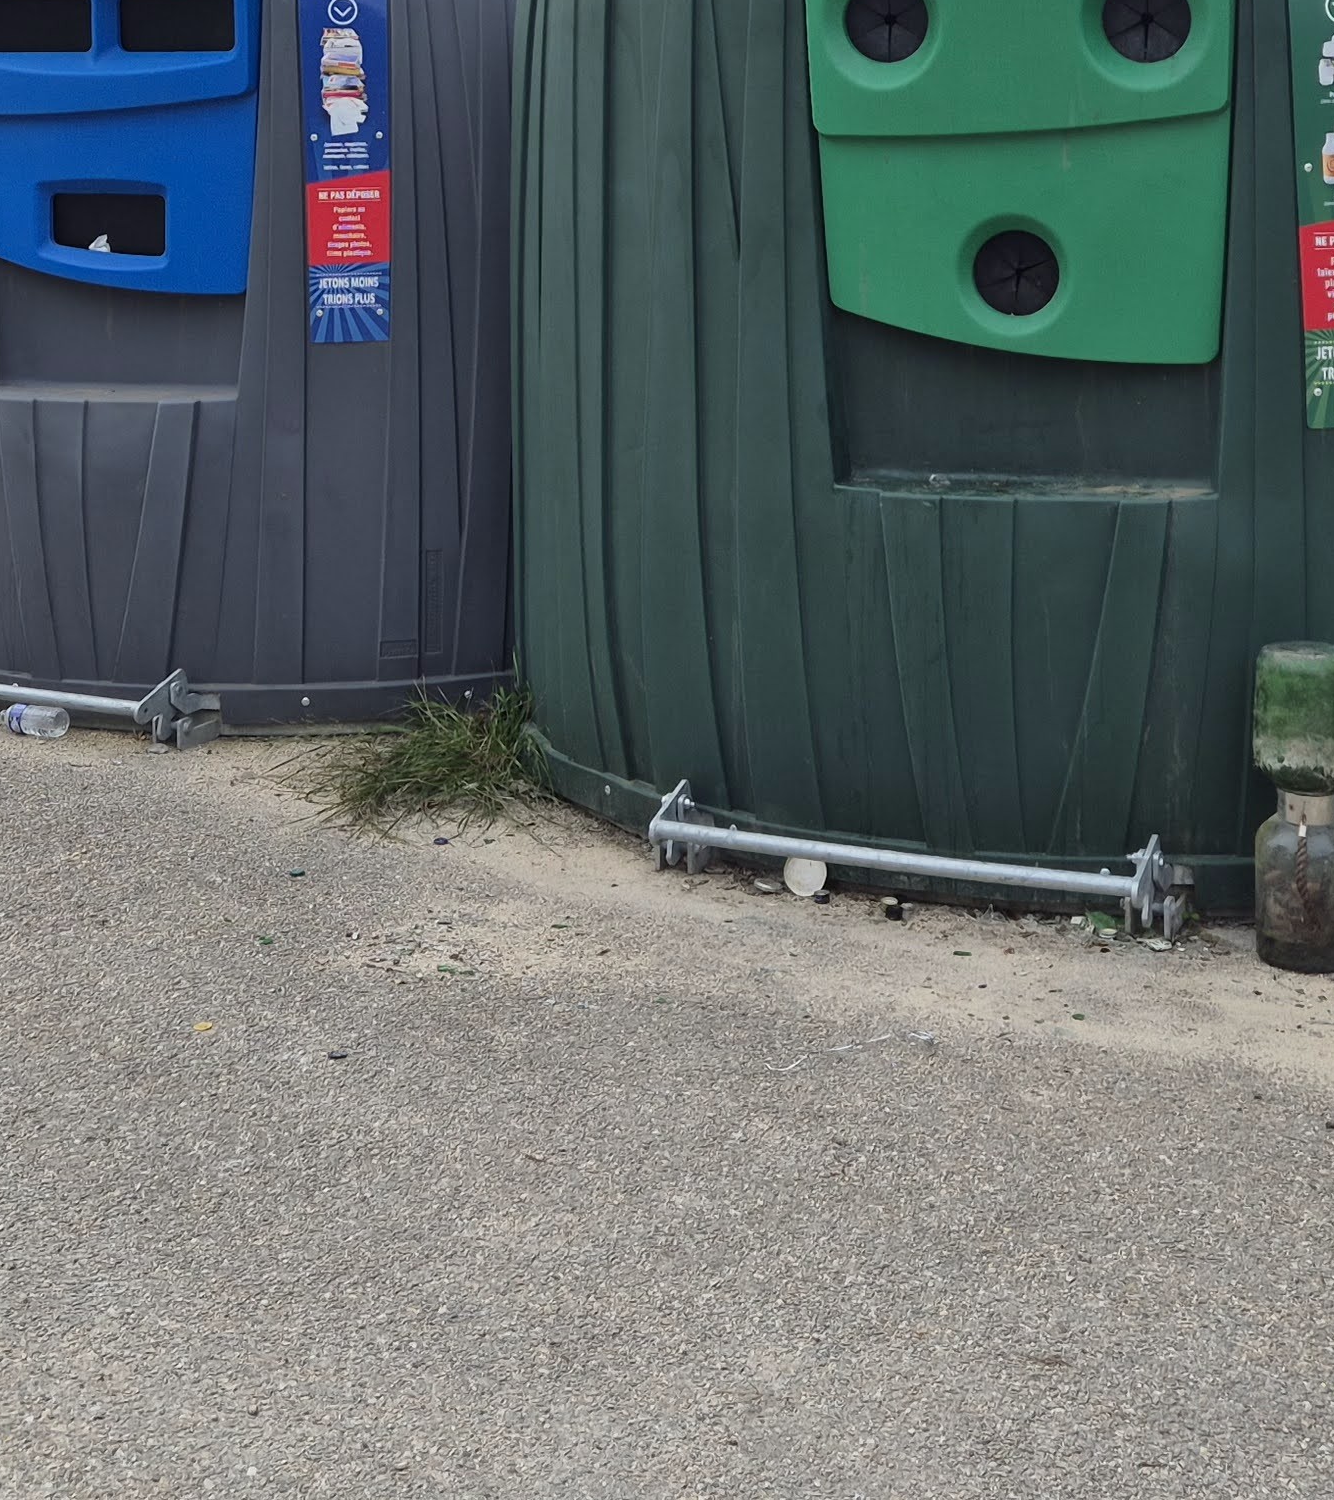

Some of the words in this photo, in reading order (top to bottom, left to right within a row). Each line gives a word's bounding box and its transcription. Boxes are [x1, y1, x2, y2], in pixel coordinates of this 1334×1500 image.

[330, 191, 345, 199] PAS
[1315, 235, 1327, 246] NE
[319, 277, 349, 288] JETONS
[351, 276, 379, 288] MOINS
[322, 293, 353, 305] TRIONS
[355, 292, 376, 304] PLUS
